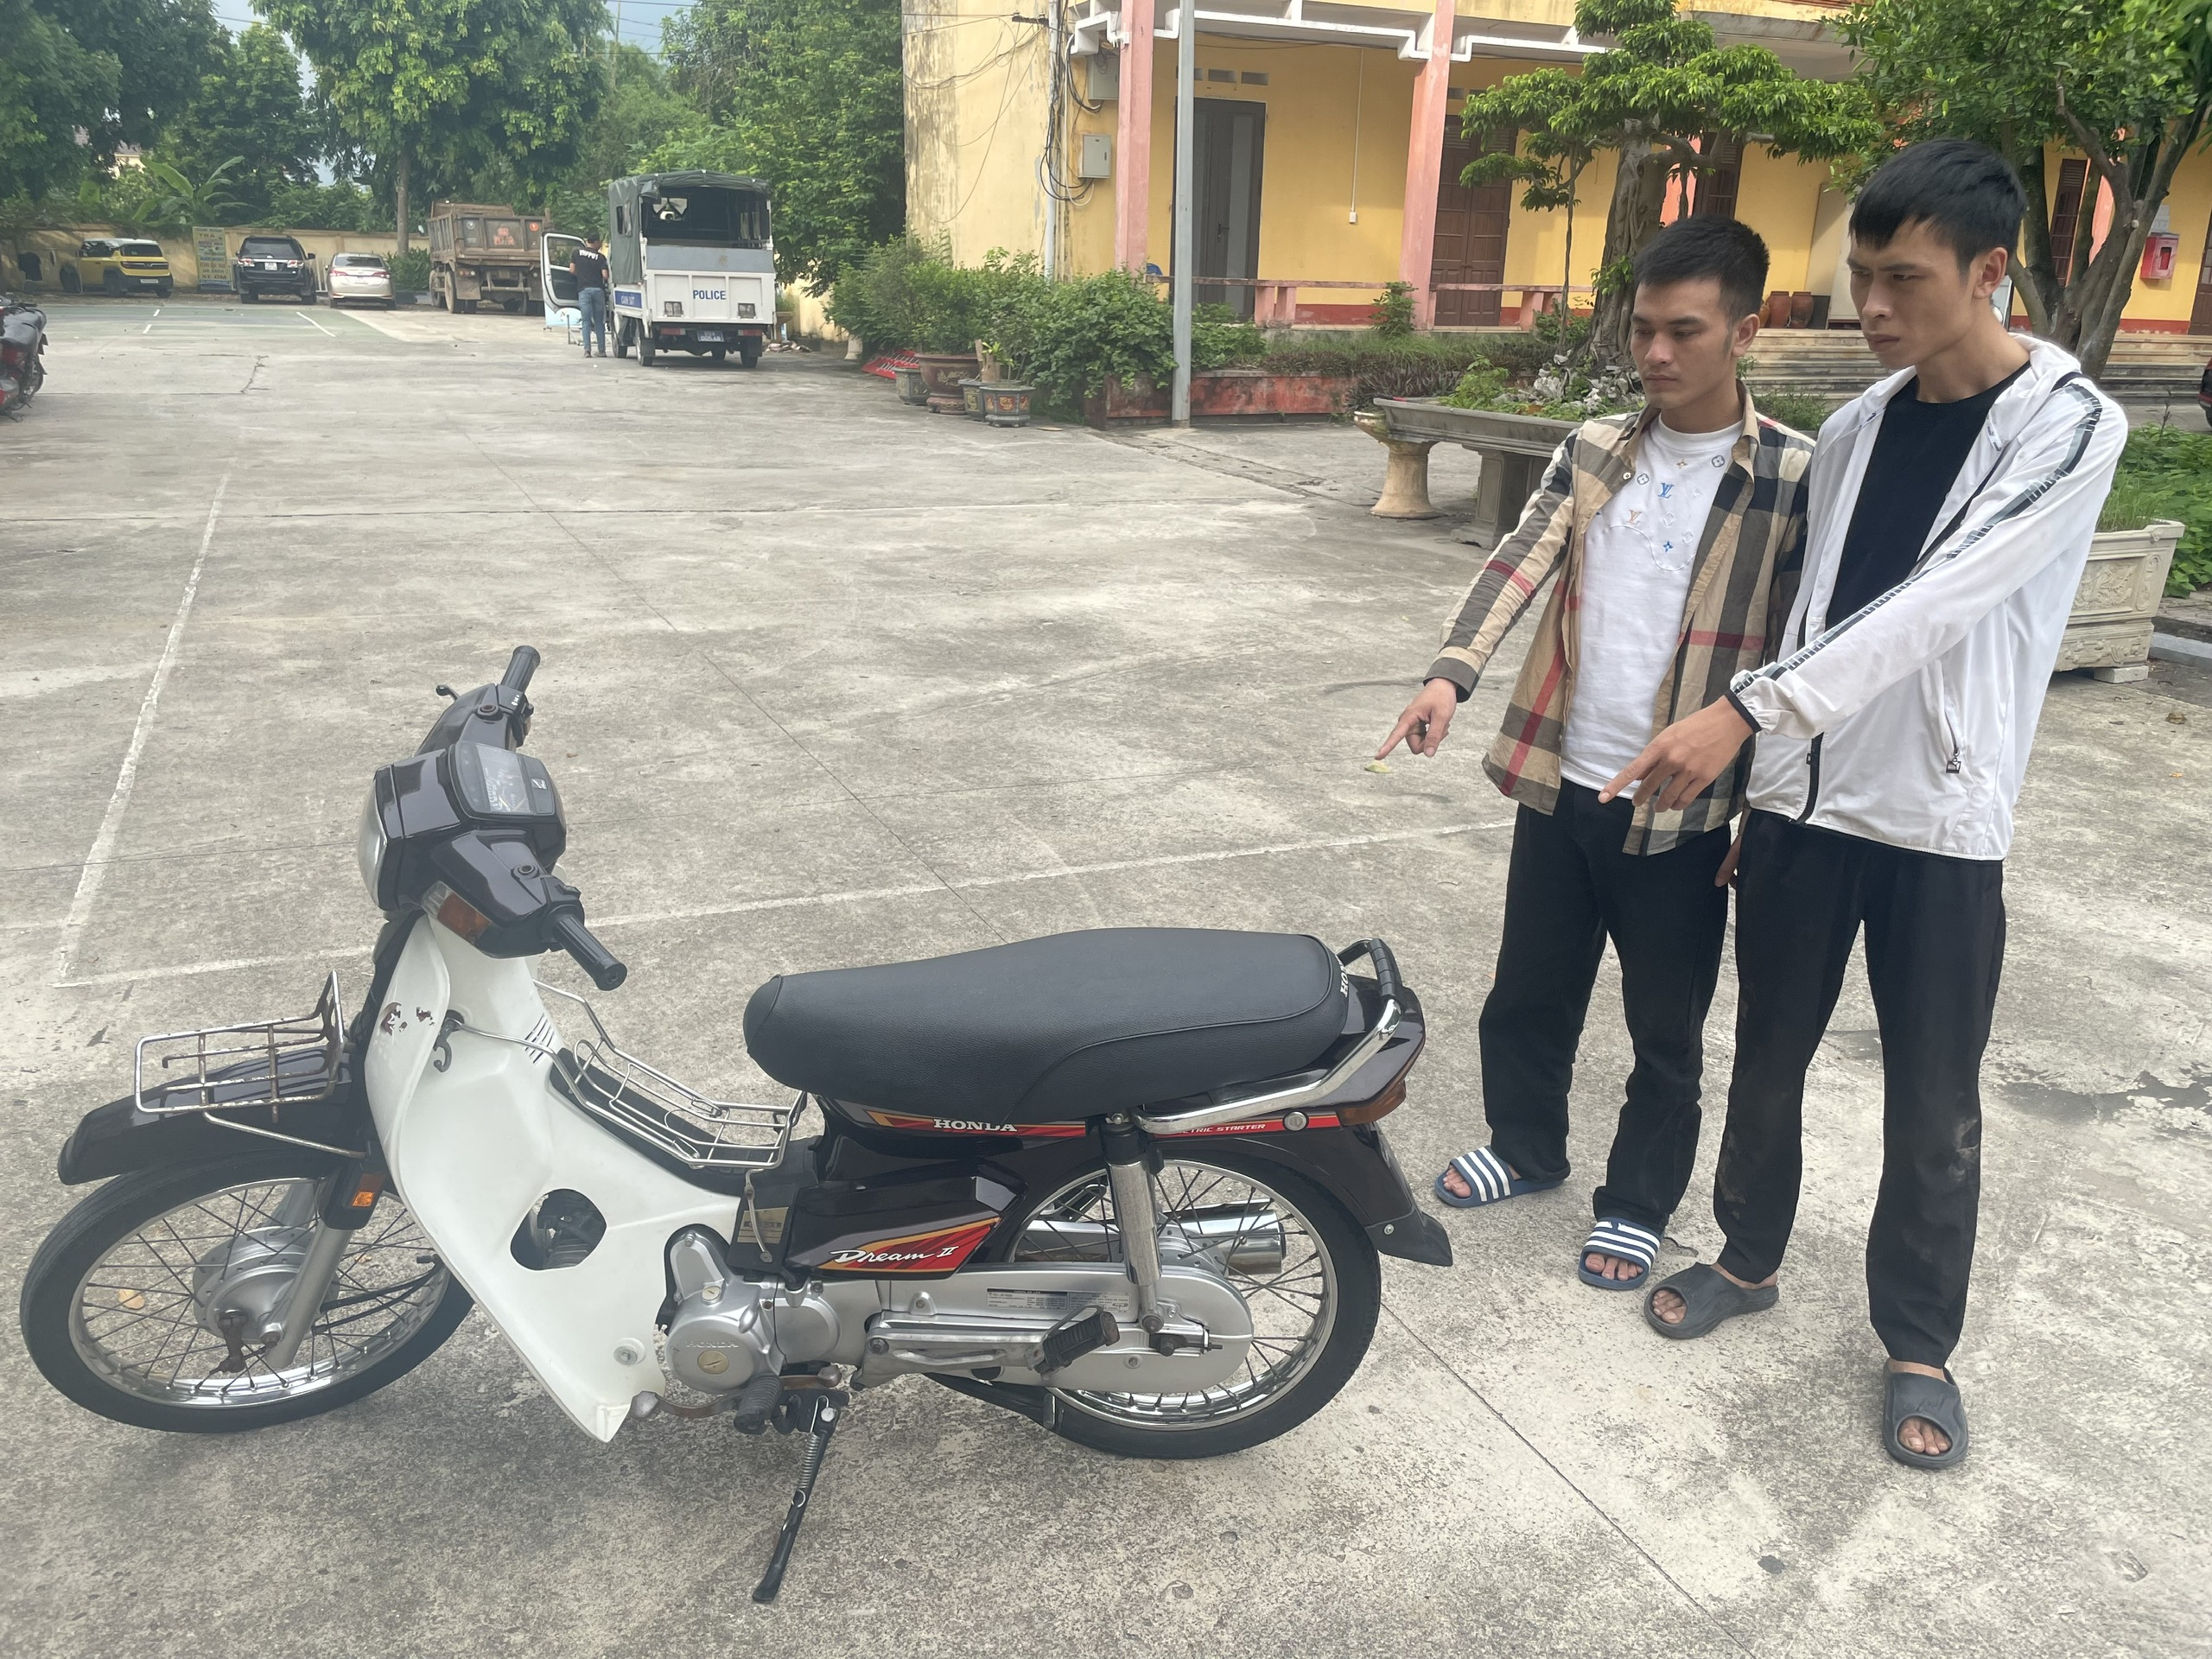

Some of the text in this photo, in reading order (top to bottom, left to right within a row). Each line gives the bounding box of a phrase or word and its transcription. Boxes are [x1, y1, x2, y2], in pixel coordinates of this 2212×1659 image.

[692, 289, 727, 300] POLICE
[933, 1118, 1018, 1132] HONDA
[1216, 1123, 1266, 1132] STARTER
[830, 1245, 959, 1263] Dream II
